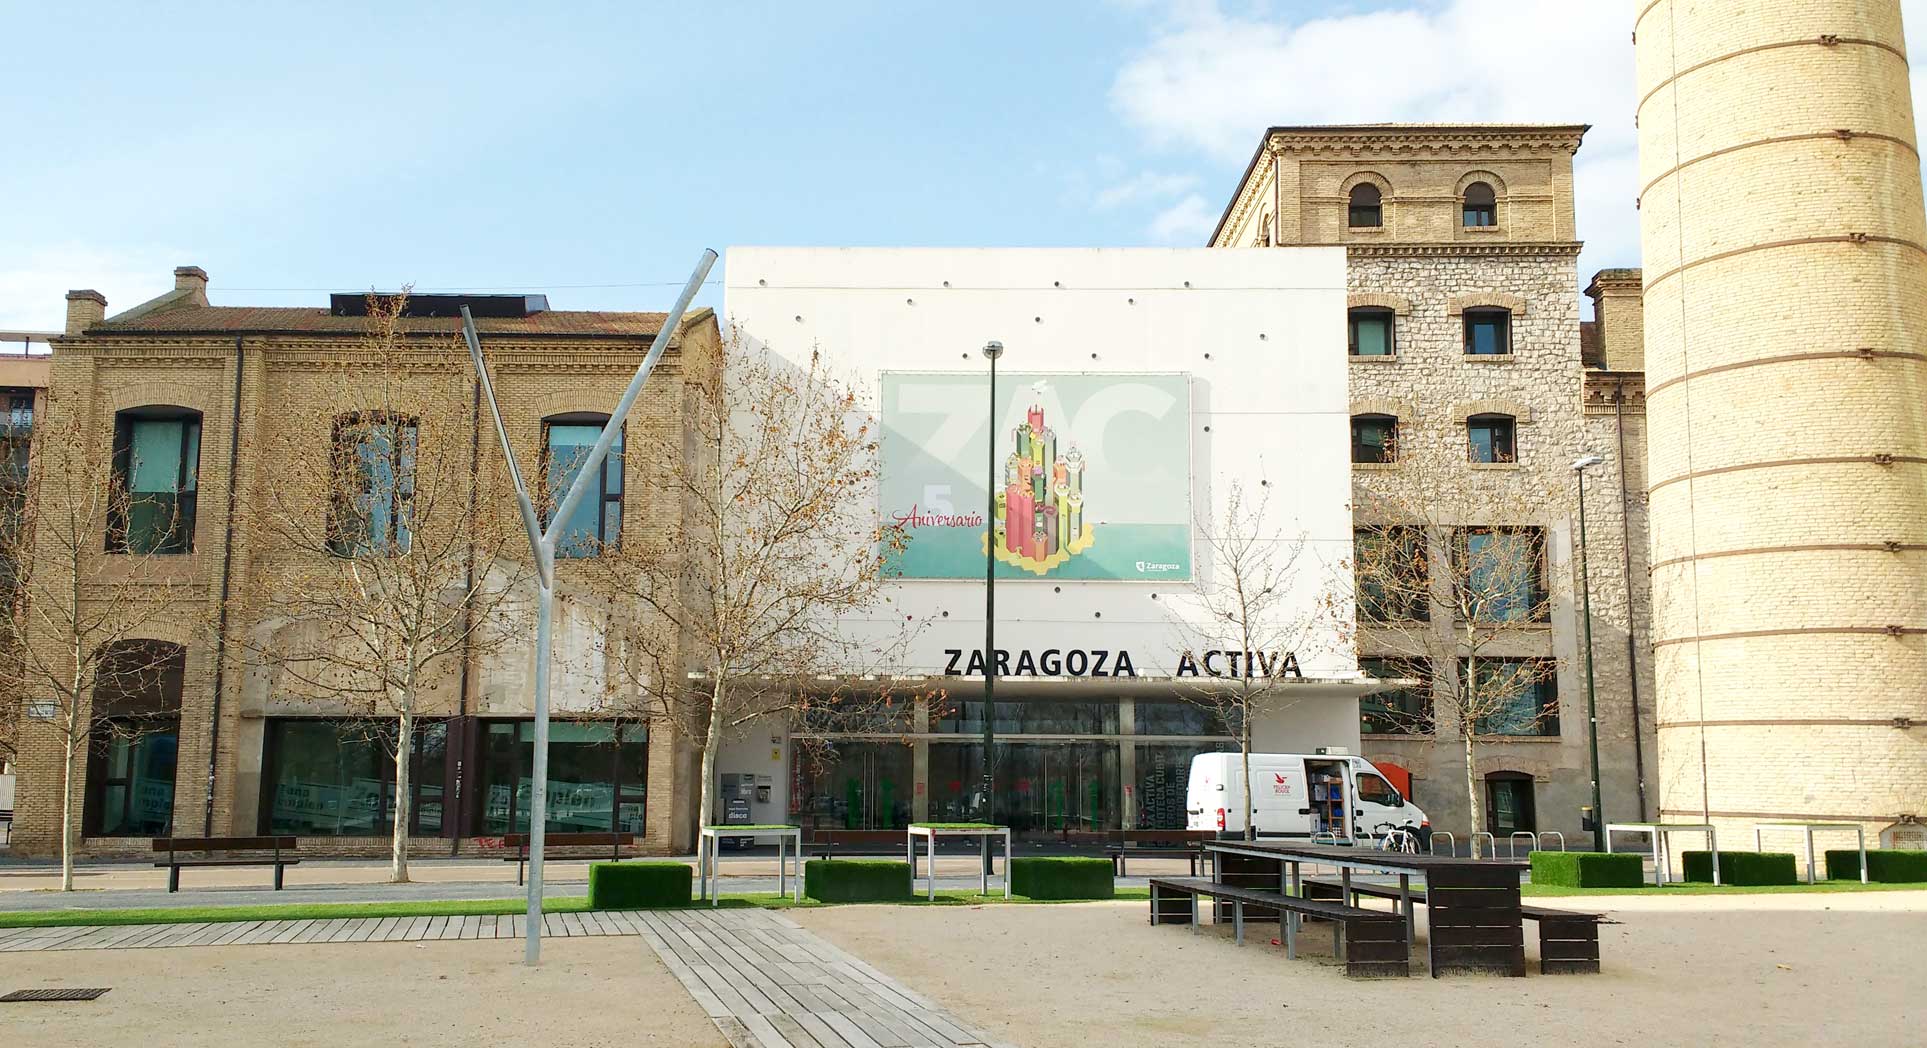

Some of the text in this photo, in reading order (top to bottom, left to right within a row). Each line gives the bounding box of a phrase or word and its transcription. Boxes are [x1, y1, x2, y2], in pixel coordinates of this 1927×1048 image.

[890, 503, 982, 528] Aniversario
[922, 484, 955, 524] 5
[1145, 562, 1180, 572] Zaragoza
[944, 649, 1303, 677] ZARAGOZA ACTIVA
